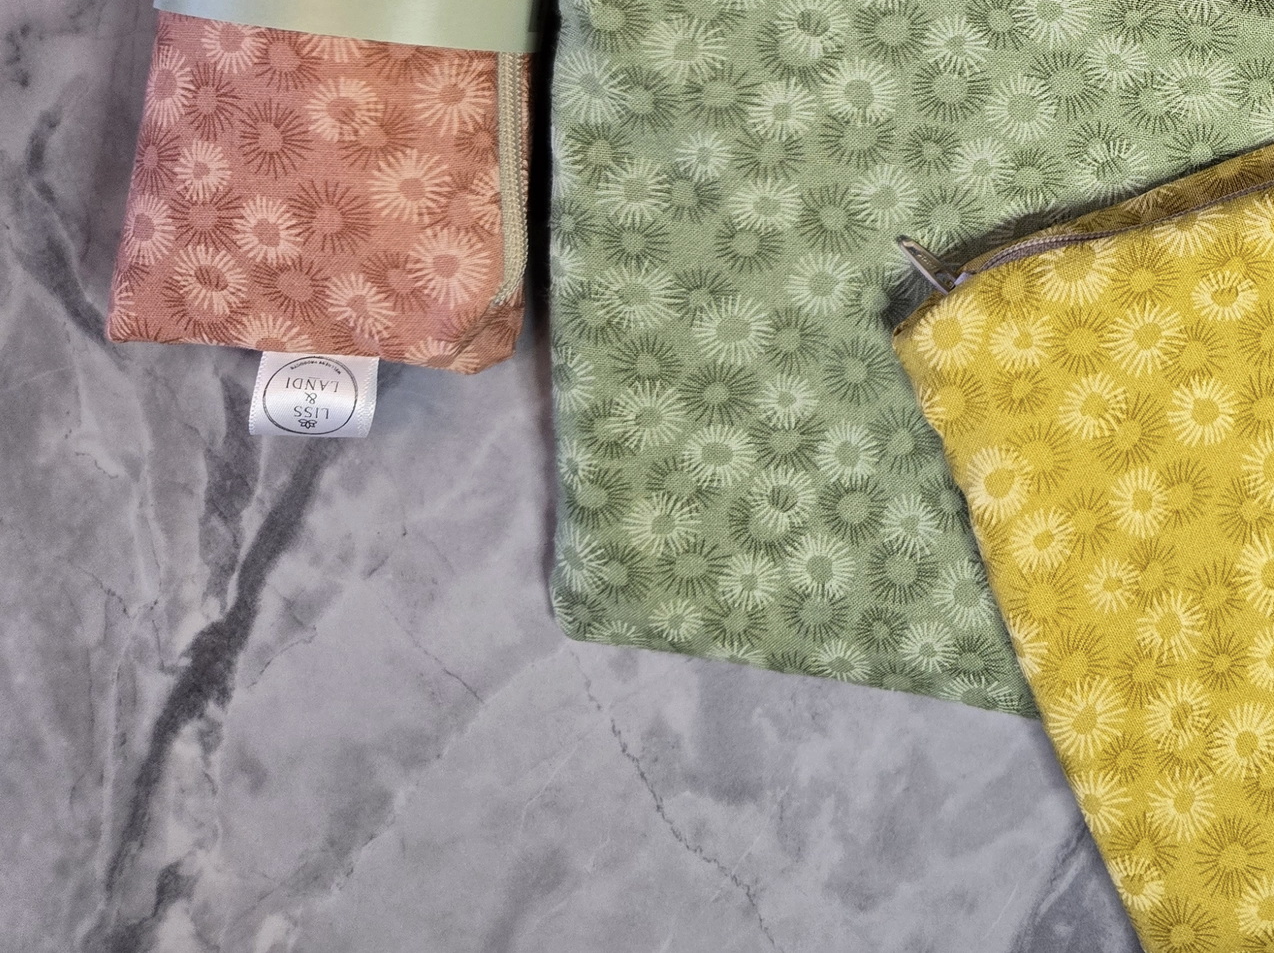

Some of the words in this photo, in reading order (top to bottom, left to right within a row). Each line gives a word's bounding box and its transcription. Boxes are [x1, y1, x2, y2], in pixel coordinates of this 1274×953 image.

[285, 376, 340, 393] LANDI
[304, 391, 318, 405] &
[293, 405, 330, 420] LISS
